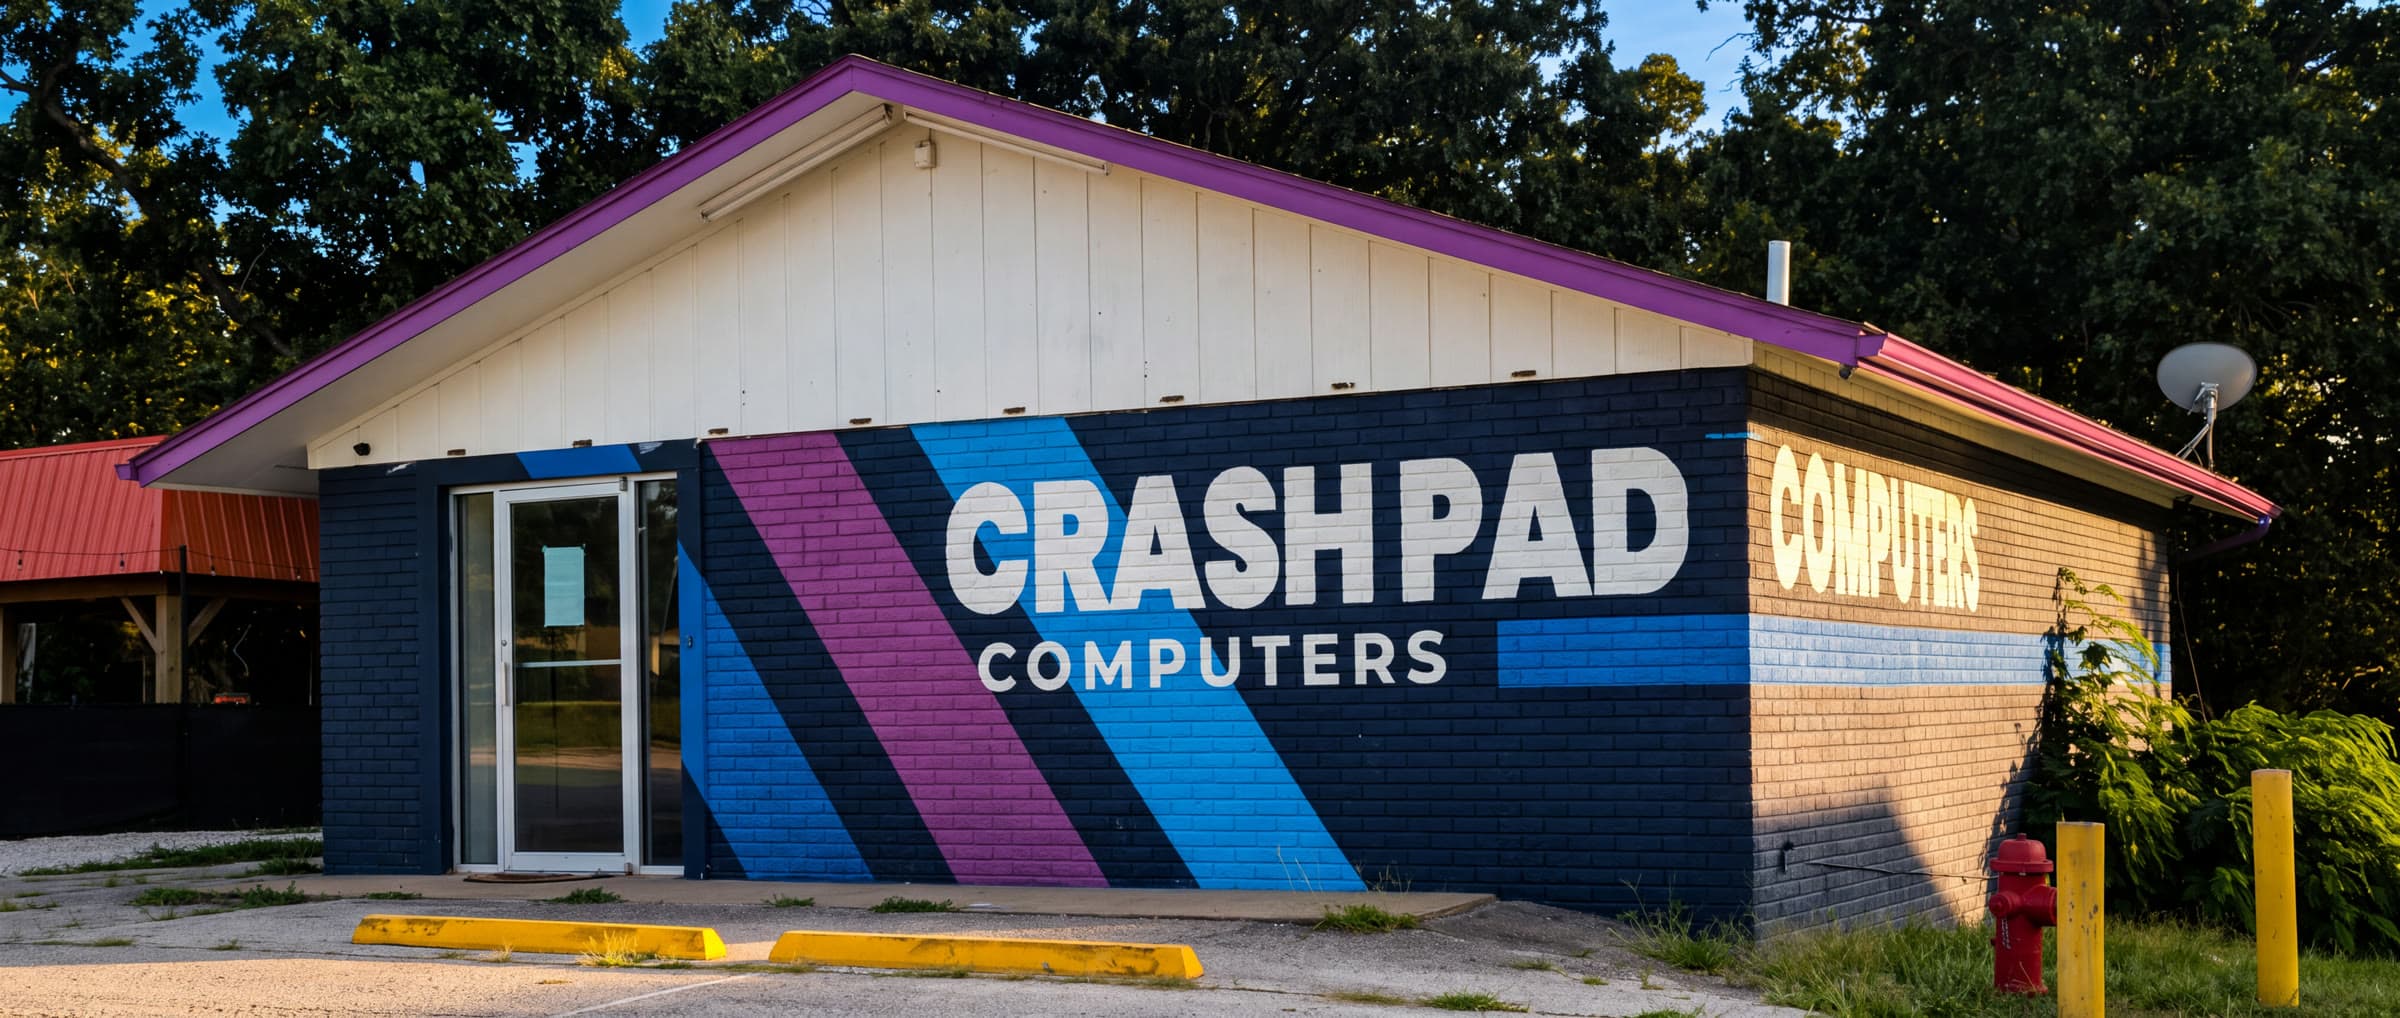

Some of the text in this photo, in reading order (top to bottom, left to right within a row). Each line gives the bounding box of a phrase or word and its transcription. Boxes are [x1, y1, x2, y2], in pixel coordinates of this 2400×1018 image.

[946, 447, 1689, 614] CRASH PAD
[1770, 444, 1980, 612] COMPUTERS
[977, 630, 1447, 693] COMPUTERS
